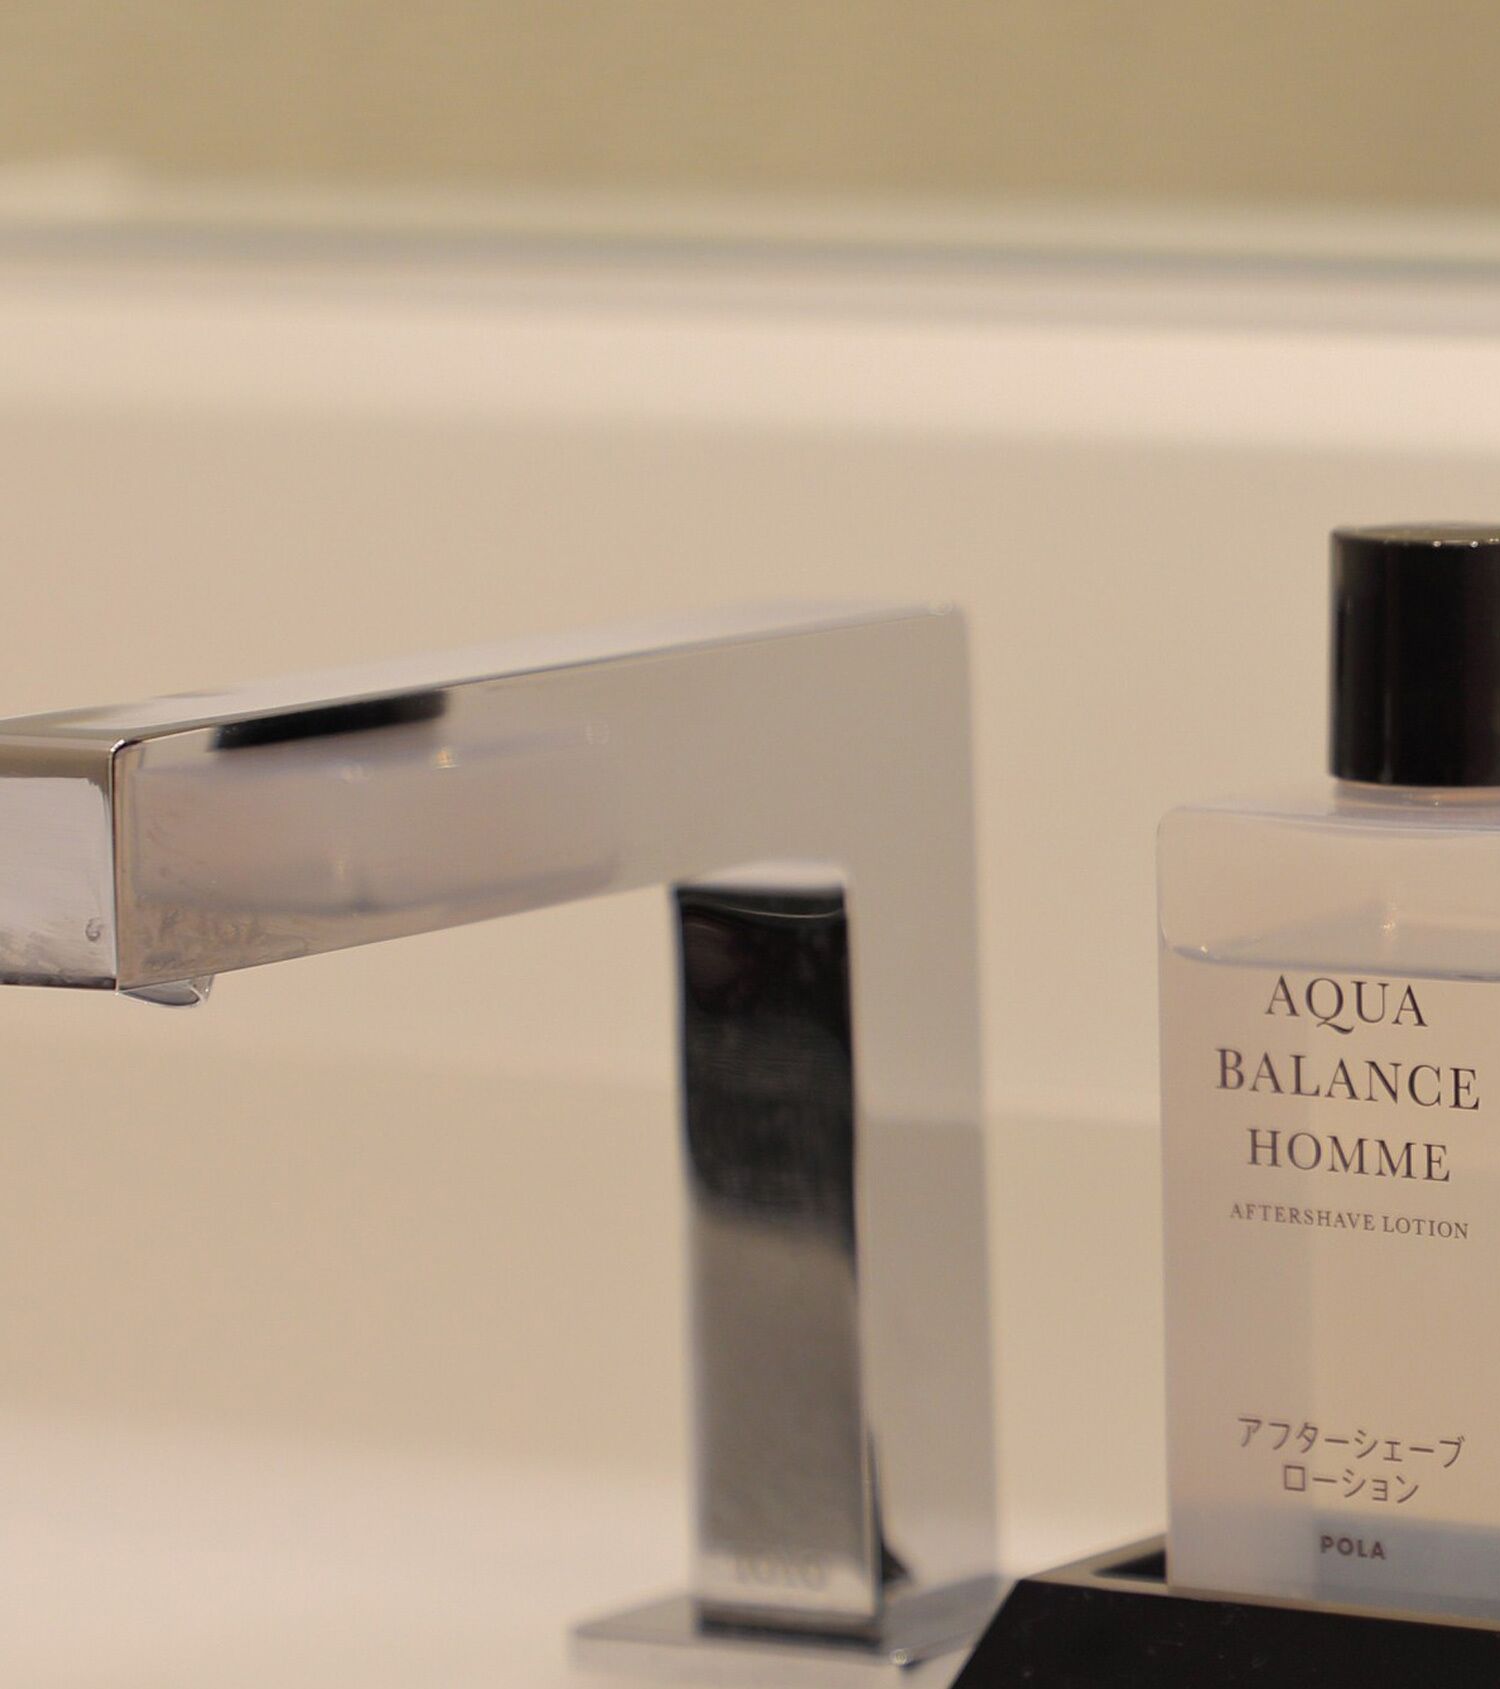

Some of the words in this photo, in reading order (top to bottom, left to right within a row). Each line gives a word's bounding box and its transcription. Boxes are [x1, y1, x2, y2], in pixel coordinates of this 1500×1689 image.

[1264, 974, 1428, 1034] AQUA
[1215, 1048, 1480, 1110] BALANCE
[1246, 1128, 1451, 1182] HOMME
[1230, 1203, 1375, 1232] AFTERSHAVE
[1382, 1215, 1469, 1239] LOTION
[1238, 1417, 1465, 1468] アフターシェーブ
[1284, 1464, 1420, 1503] ローション
[1319, 1534, 1386, 1560] POLA
